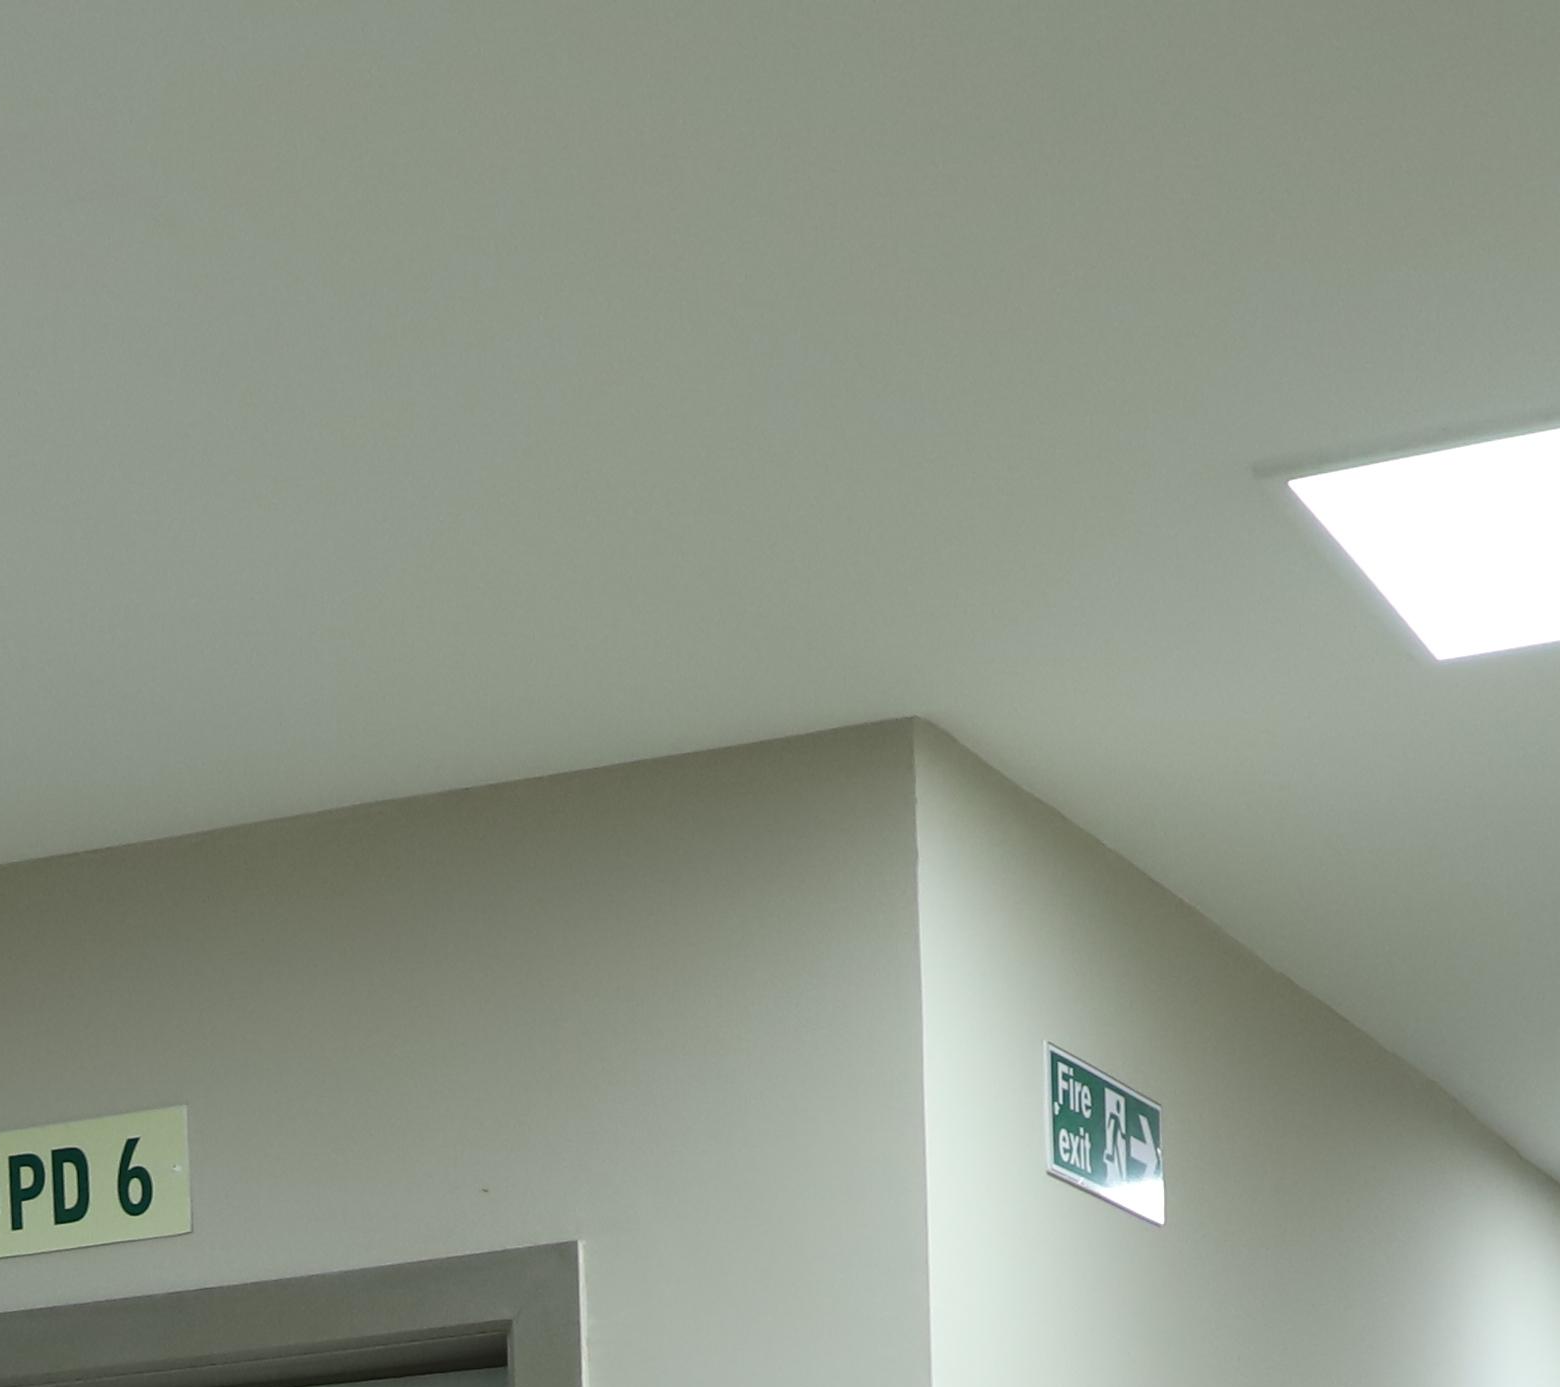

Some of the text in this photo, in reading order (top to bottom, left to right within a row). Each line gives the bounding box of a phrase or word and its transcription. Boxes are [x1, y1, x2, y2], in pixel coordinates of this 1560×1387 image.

[1057, 1061, 1093, 1119] Fire
[117, 1137, 154, 1217] 6
[1058, 1127, 1092, 1174] exit
